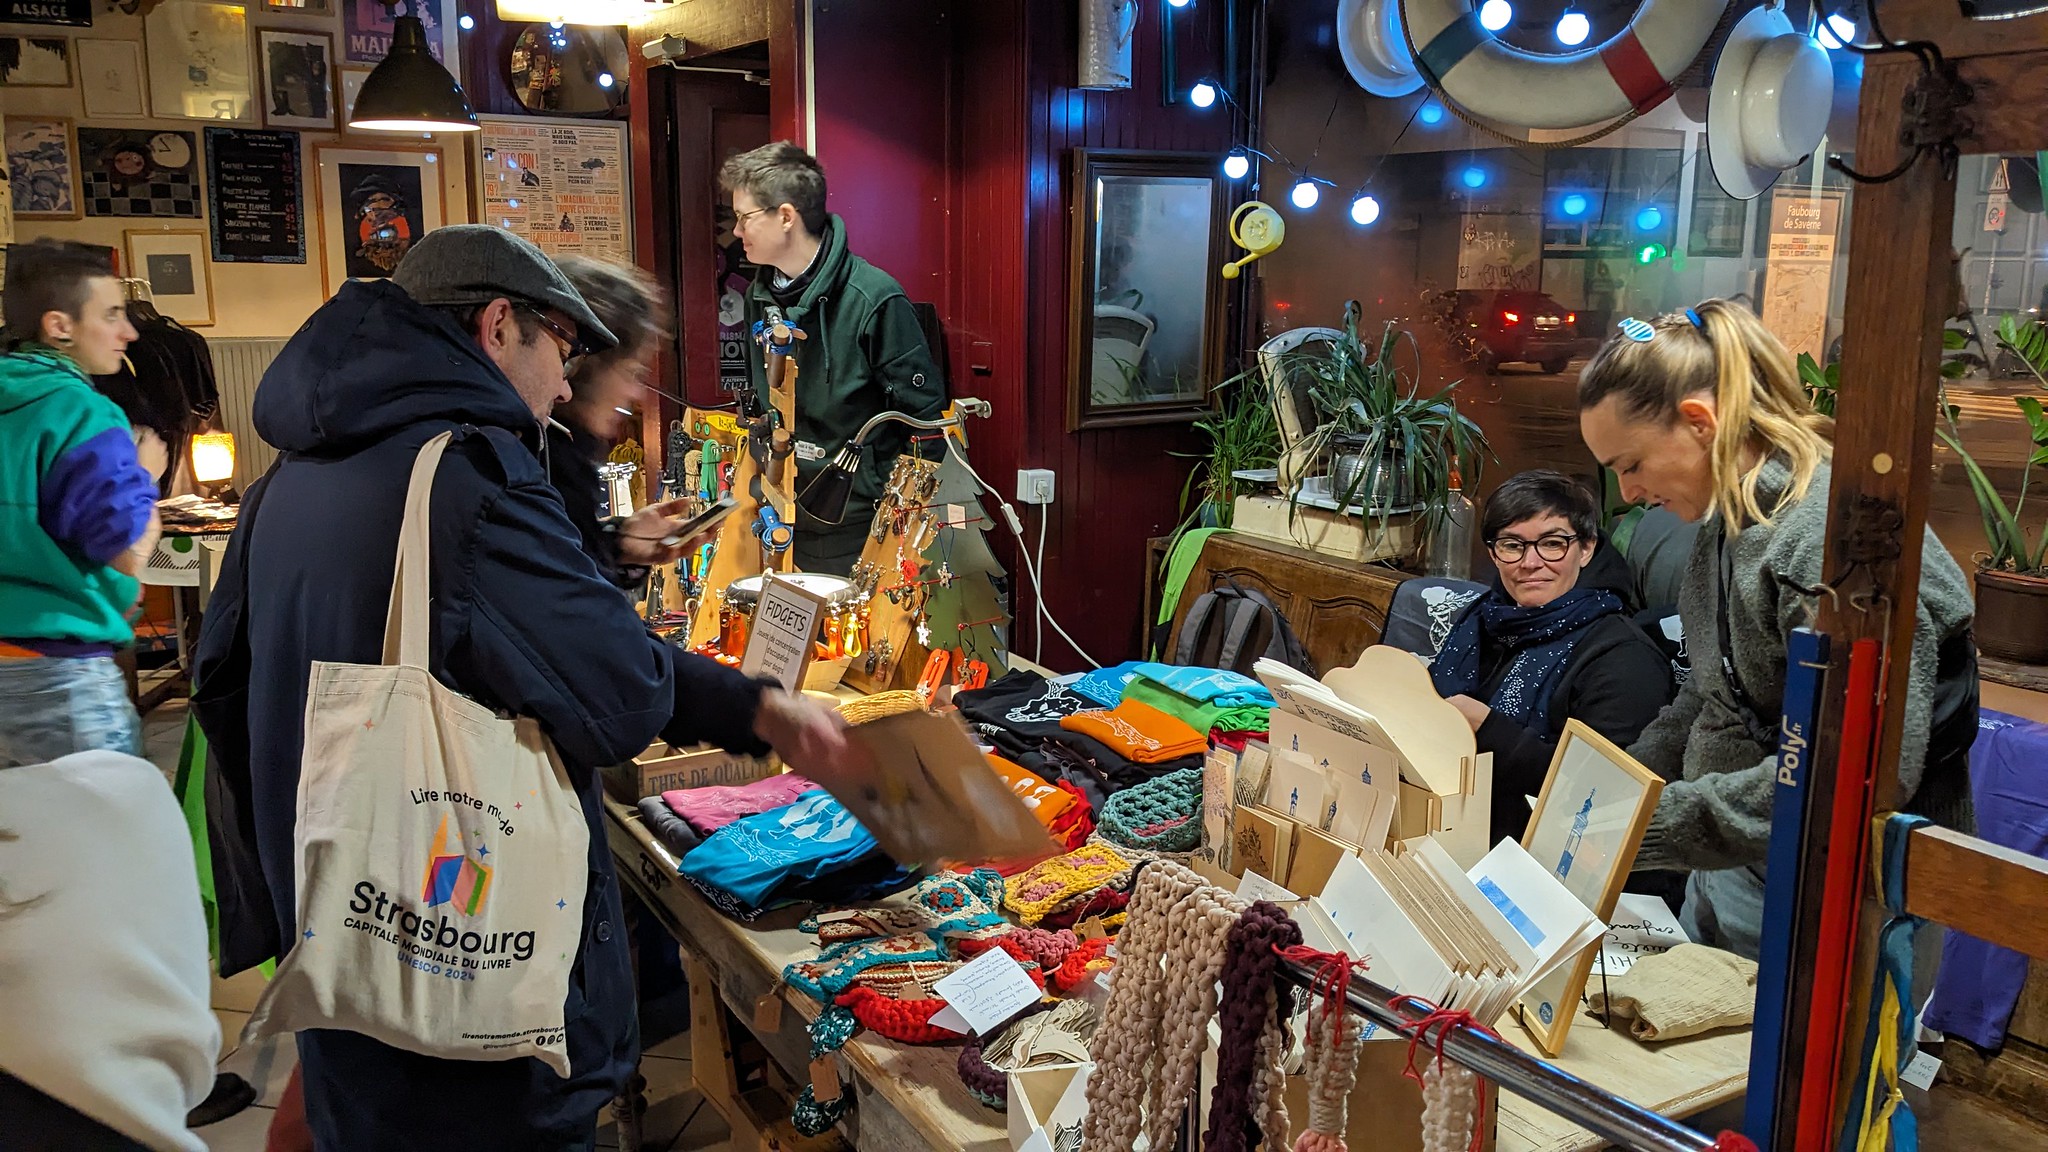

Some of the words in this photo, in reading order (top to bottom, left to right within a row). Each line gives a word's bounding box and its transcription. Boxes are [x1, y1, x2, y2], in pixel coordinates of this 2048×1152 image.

[12, 3, 68, 17] ALSACE
[518, 152, 535, 169] CON
[1787, 205, 1821, 220] Faubourg
[1783, 218, 1793, 229] de
[1793, 218, 1822, 230] Saverne
[765, 600, 807, 632] FIDGETS
[690, 767, 709, 787] DE
[410, 788, 439, 805] Lire
[443, 790, 484, 810] notre
[349, 880, 536, 961] Strasbourg
[343, 917, 400, 945] CAPITALE
[401, 938, 458, 966] MONDIALE
[461, 957, 479, 970] DU
[481, 958, 512, 970] LIVRE
[397, 950, 441, 975] UNESCO
[444, 968, 476, 982] 2024
